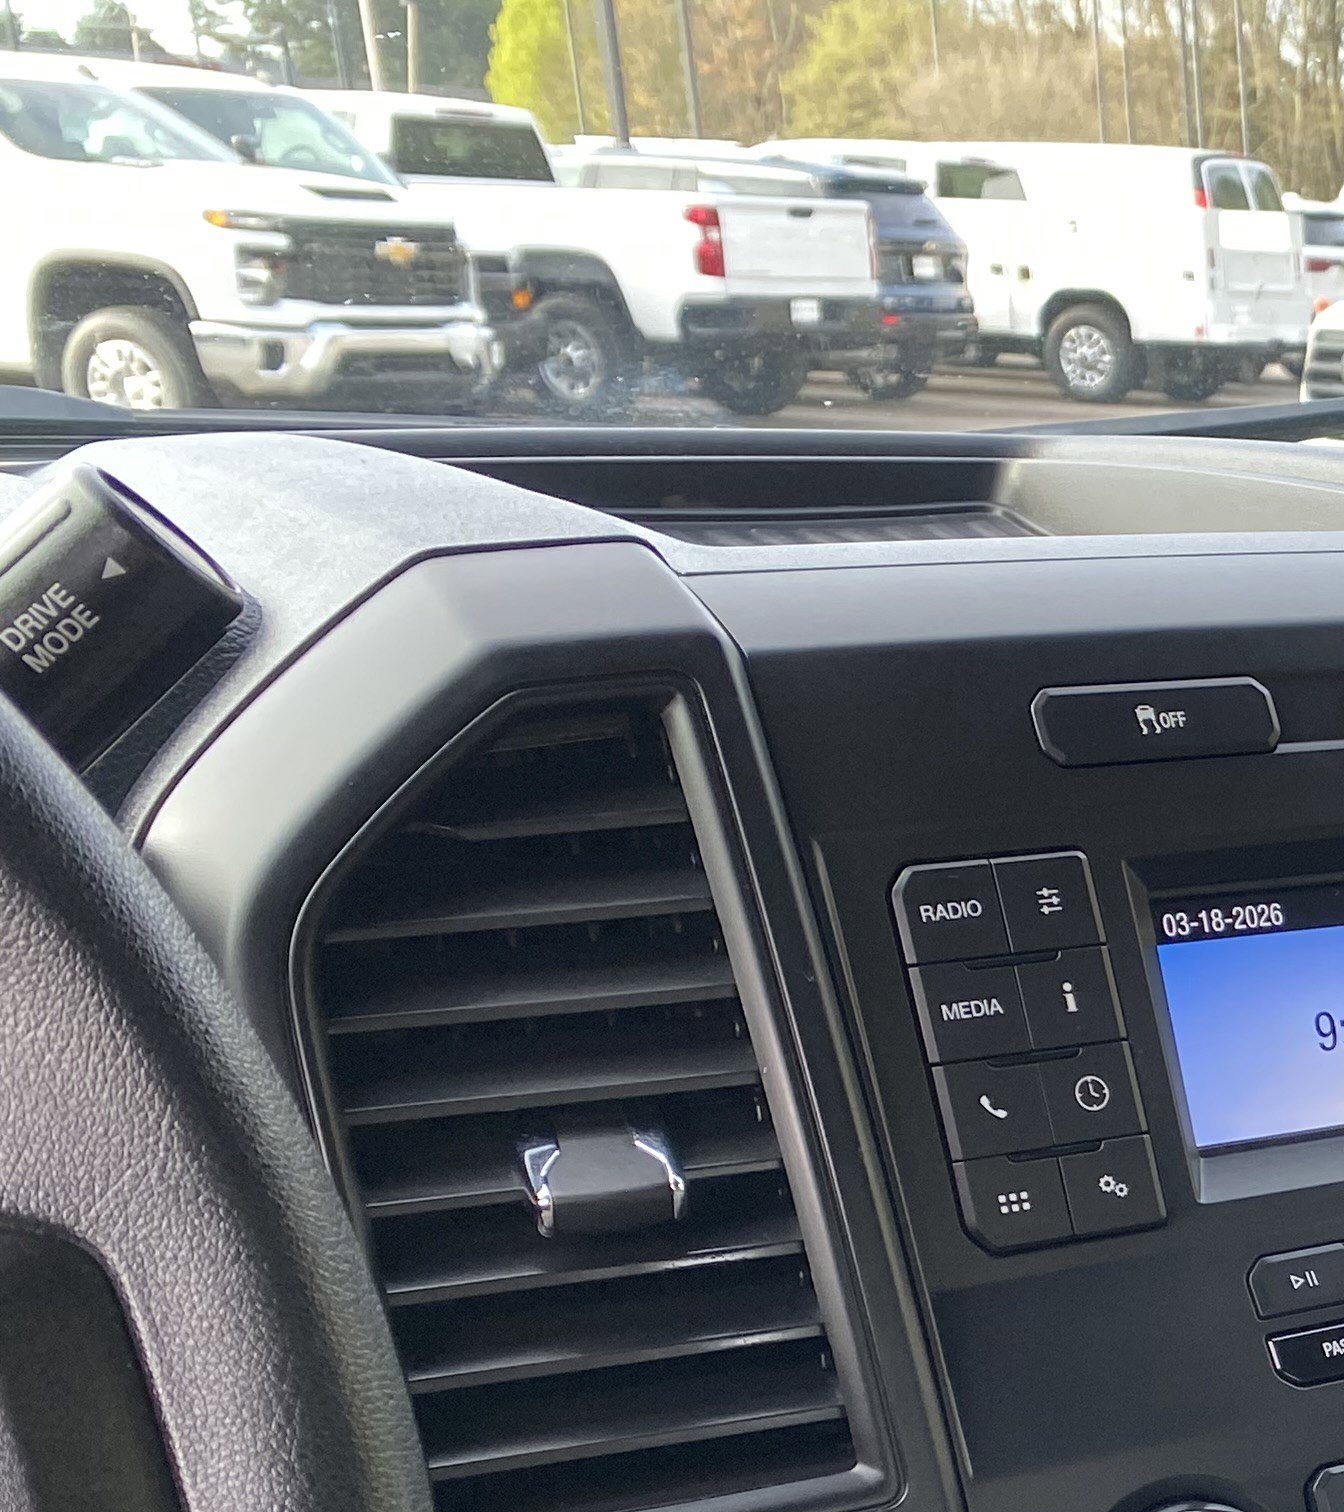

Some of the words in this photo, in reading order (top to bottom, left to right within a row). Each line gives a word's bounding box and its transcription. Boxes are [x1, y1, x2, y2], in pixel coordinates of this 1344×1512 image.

[0, 582, 76, 652] DRIVE
[21, 603, 100, 674] MODE
[1159, 710, 1187, 730] OFF
[919, 899, 982, 924] RADIO
[1162, 902, 1284, 938] 03-18-2026
[940, 998, 1004, 1022] MEDIA
